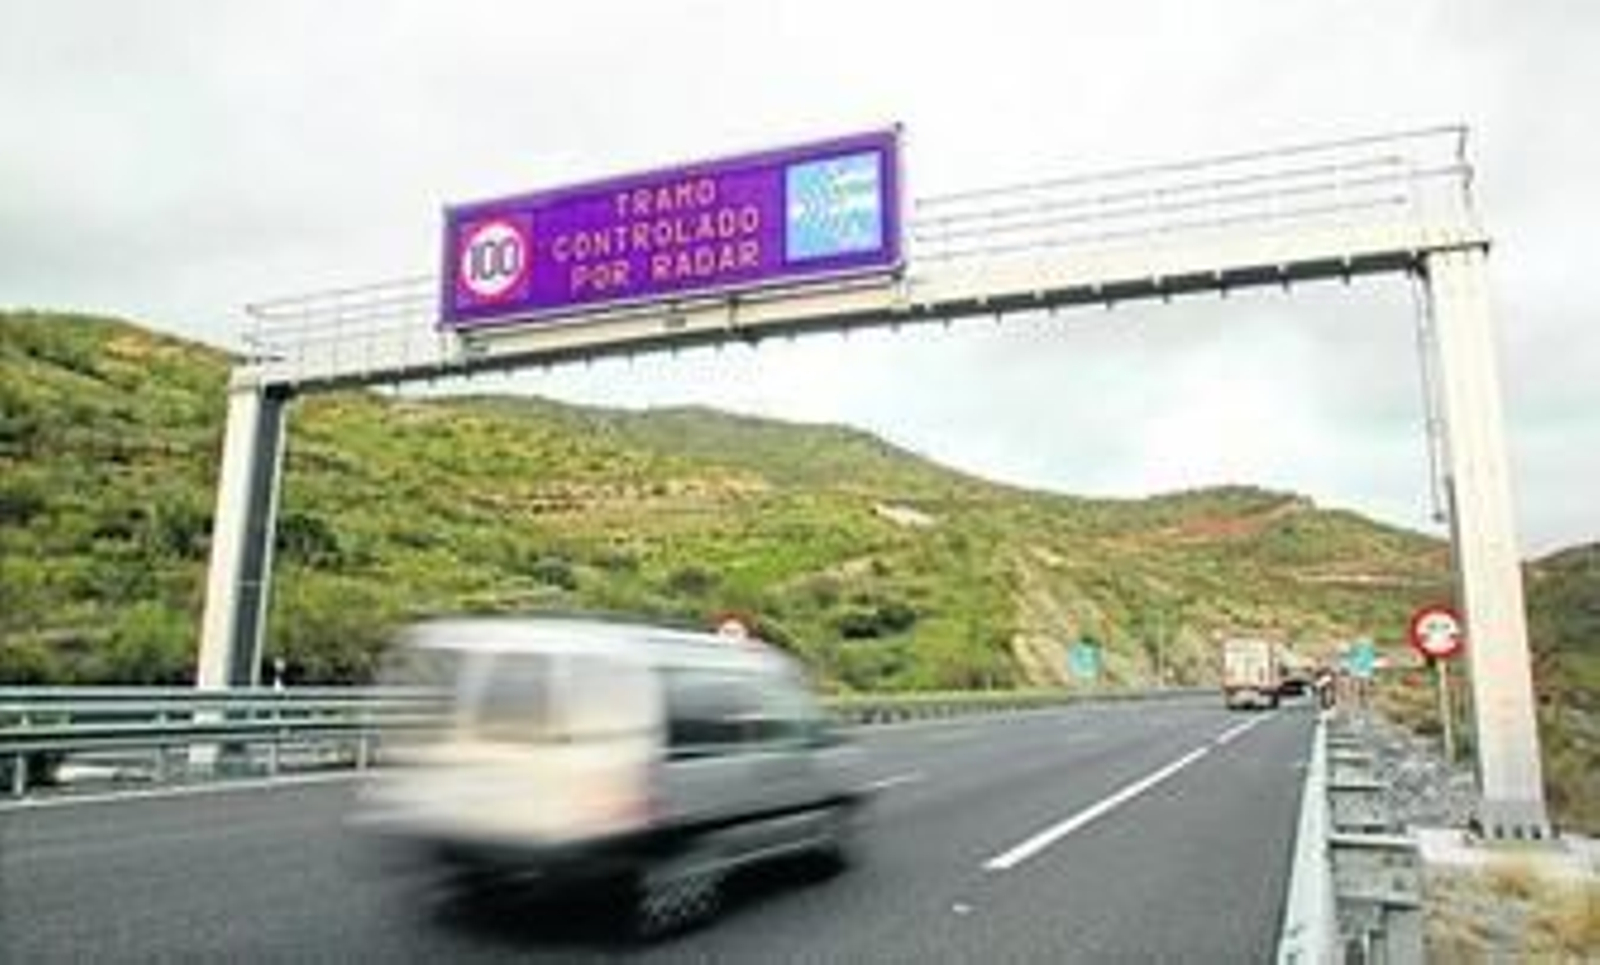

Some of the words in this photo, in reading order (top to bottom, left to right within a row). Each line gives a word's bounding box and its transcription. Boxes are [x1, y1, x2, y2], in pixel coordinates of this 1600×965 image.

[615, 179, 717, 218] TRAMO
[551, 206, 760, 262] CONTROLADO
[469, 237, 518, 281] 100
[570, 259, 631, 292] POR
[652, 240, 760, 282] RADAR
